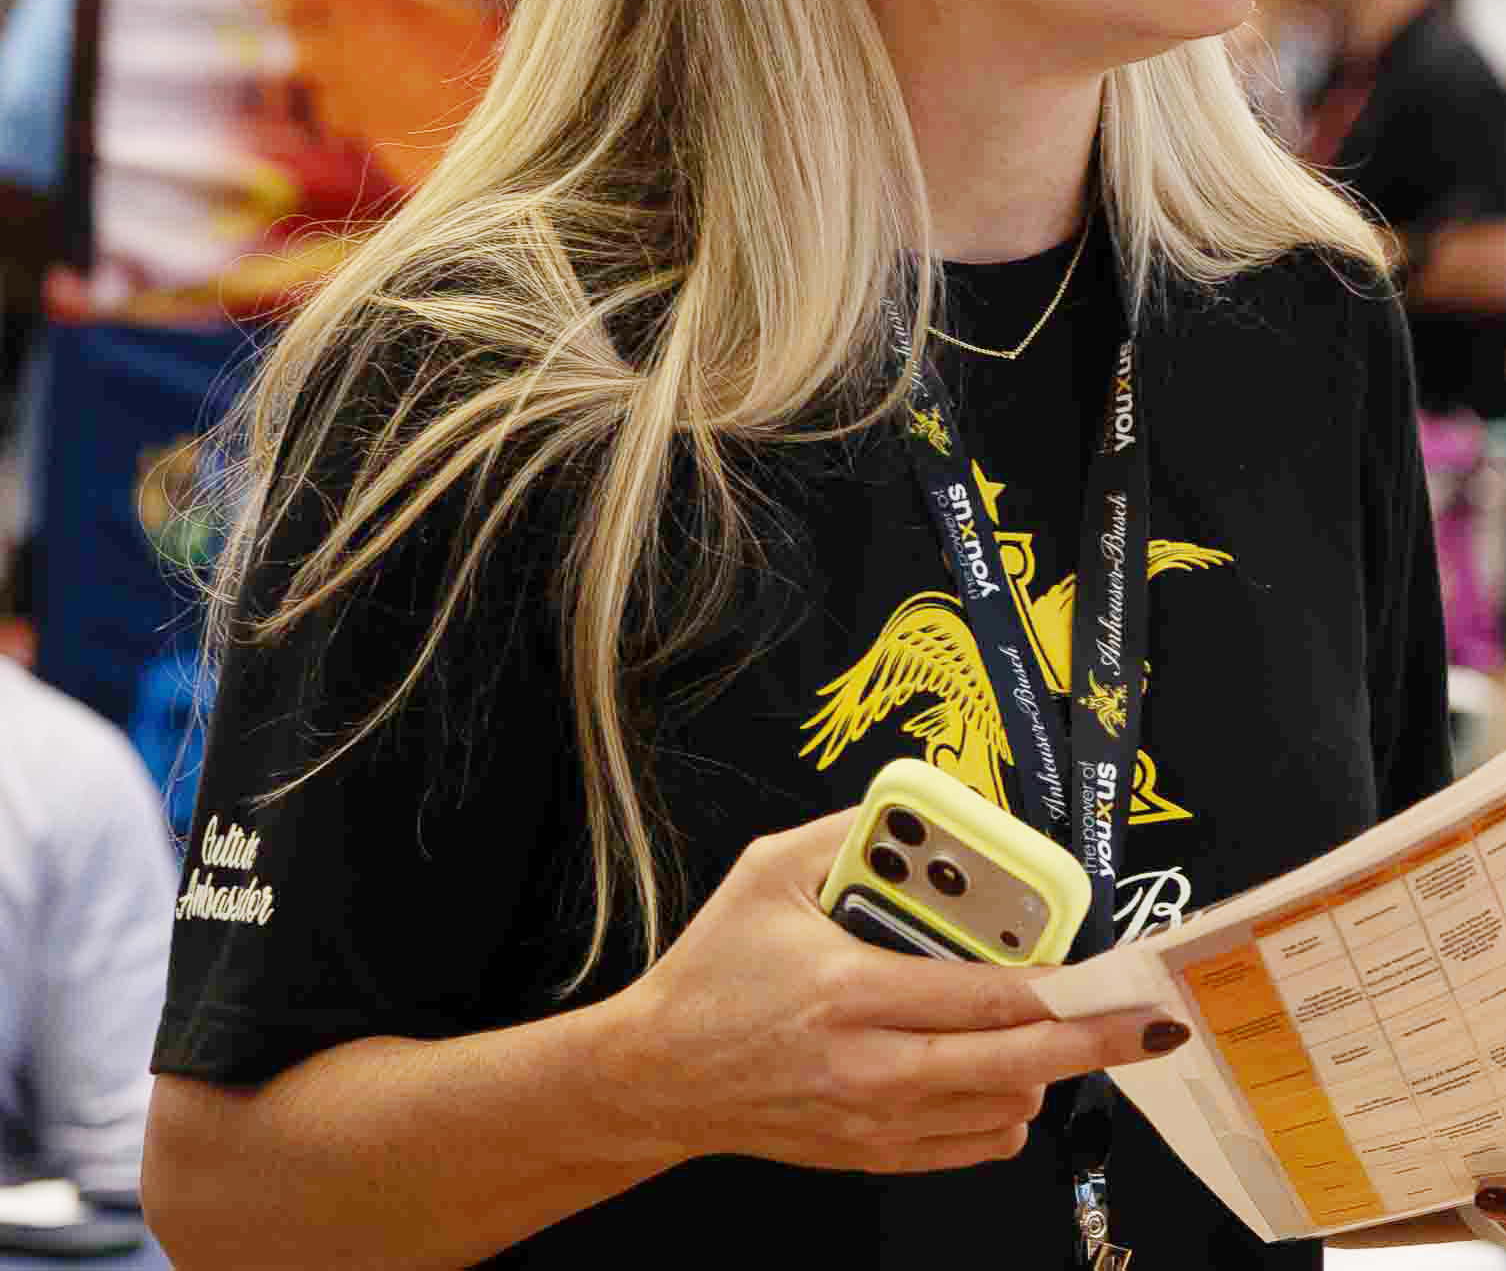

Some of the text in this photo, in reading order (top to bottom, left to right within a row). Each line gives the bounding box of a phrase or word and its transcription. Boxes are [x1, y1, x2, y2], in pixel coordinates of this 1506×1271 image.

[947, 482, 1001, 599] youxus
[1096, 489, 1128, 677] Anheuser-Busch
[999, 643, 1070, 826] Anheuser-Busch
[1078, 760, 1097, 779] of
[1081, 784, 1098, 844] power
[1095, 761, 1117, 881] youxus
